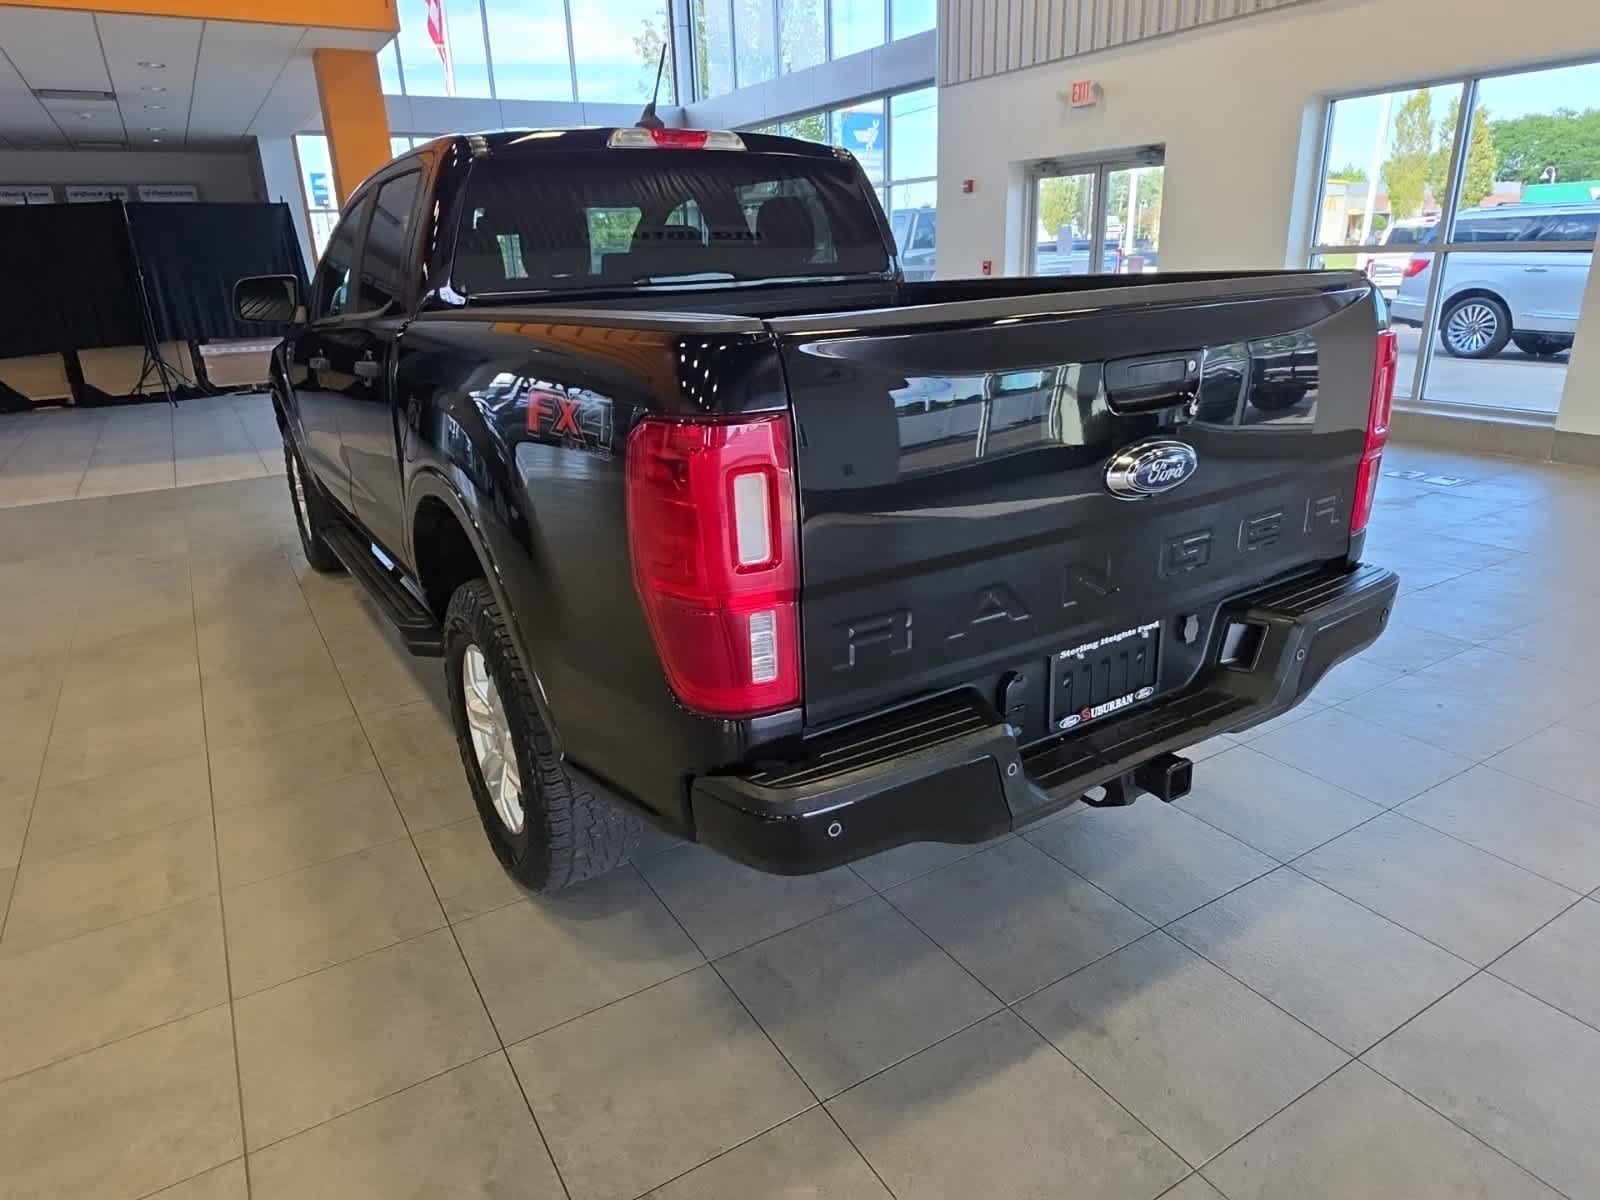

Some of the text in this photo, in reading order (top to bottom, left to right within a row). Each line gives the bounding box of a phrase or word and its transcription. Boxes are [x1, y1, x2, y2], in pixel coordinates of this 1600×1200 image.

[1072, 80, 1090, 104] EXIT
[526, 385, 613, 450] FX4
[1147, 457, 1185, 484] Ford
[831, 495, 1341, 672] RANGER
[1060, 641, 1099, 660] Sterling
[1100, 629, 1137, 646] Heights
[1080, 693, 1134, 721] SUBURBAN
